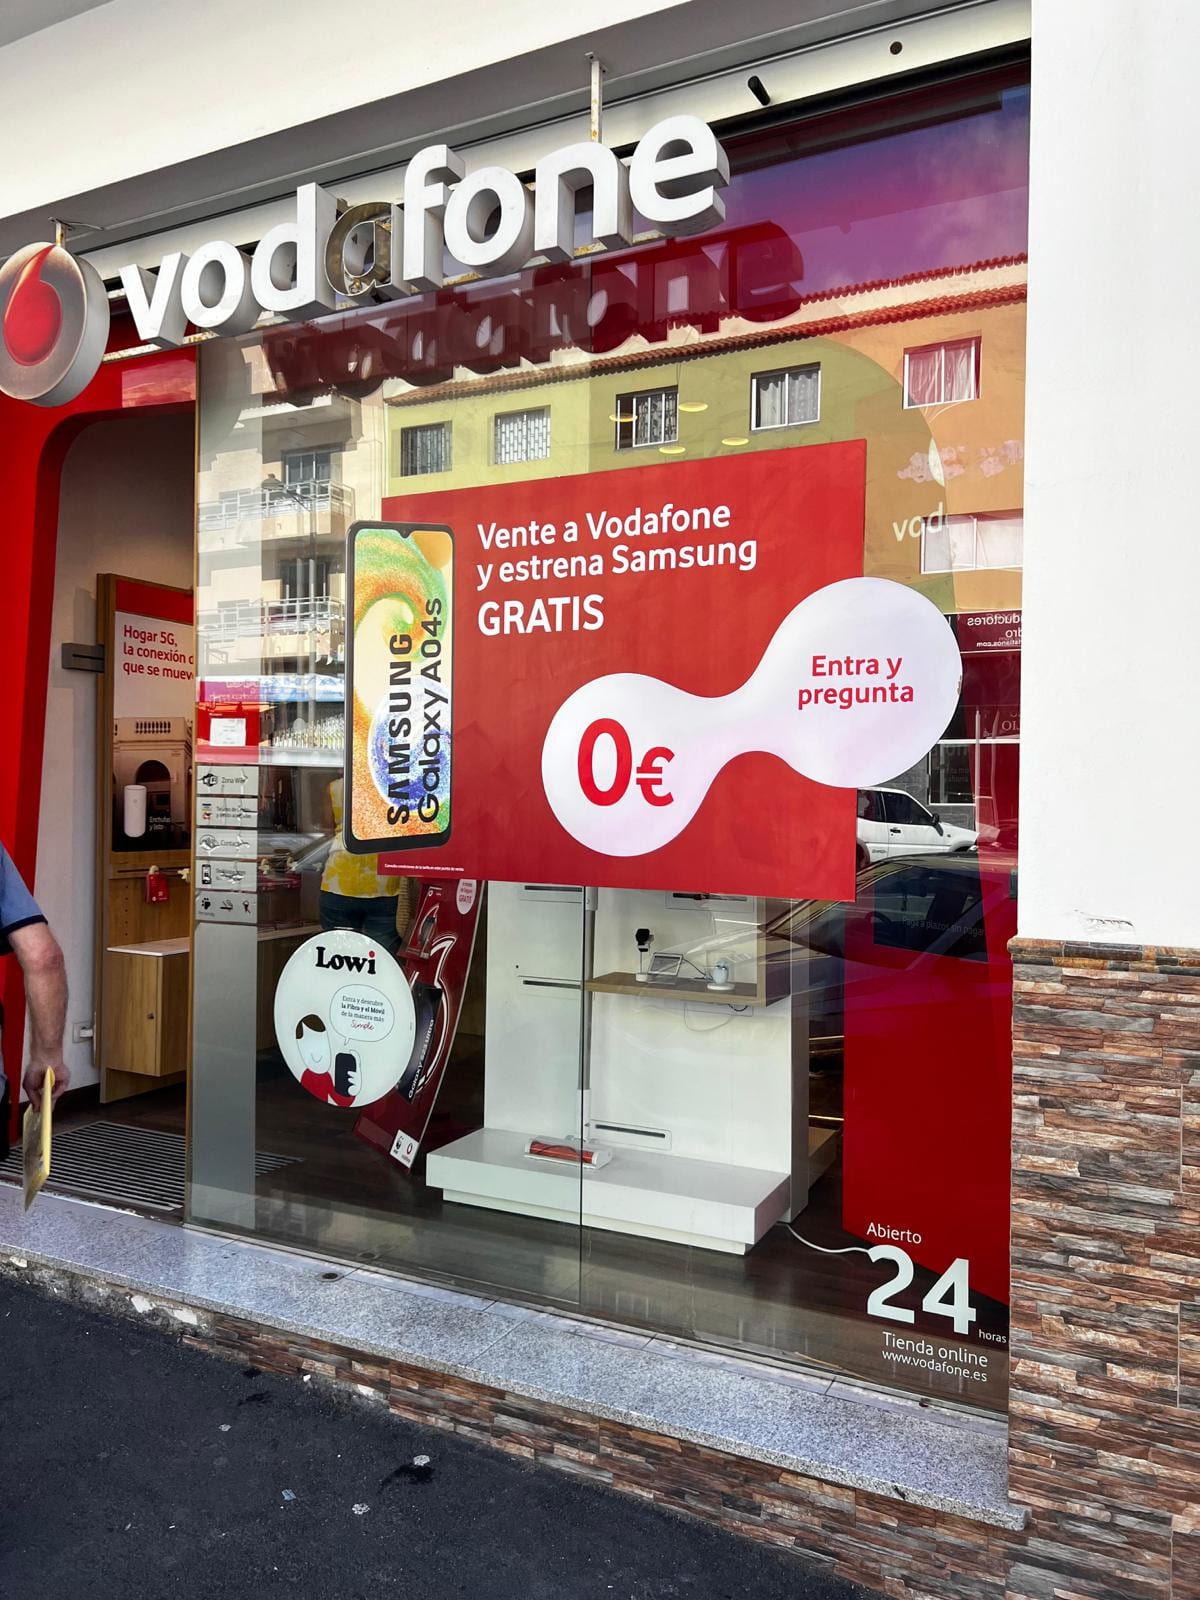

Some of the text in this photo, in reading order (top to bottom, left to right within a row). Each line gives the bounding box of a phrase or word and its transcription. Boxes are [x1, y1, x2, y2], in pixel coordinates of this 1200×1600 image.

[119, 115, 730, 346] vodafone
[477, 504, 731, 550] Vente a Vodafone
[476, 540, 756, 592] y estrena Samsung
[478, 594, 605, 636] GRATIS
[124, 625, 177, 647] Hogar 5G,
[124, 642, 133, 655] la
[137, 647, 186, 663] conexión
[123, 662, 193, 680] que se muev
[811, 655, 902, 680] Entra y
[418, 597, 449, 823] Galaxy A04s
[798, 683, 914, 710] pregunta
[387, 634, 412, 825] SAMSUNG
[578, 717, 675, 806] 0€
[315, 946, 376, 975] Lowi
[866, 1222, 922, 1244] Abierto
[867, 1244, 1007, 1343] 24 horas
[882, 1332, 988, 1367] Tienda online
[882, 1351, 987, 1382] www.vodafone.es
